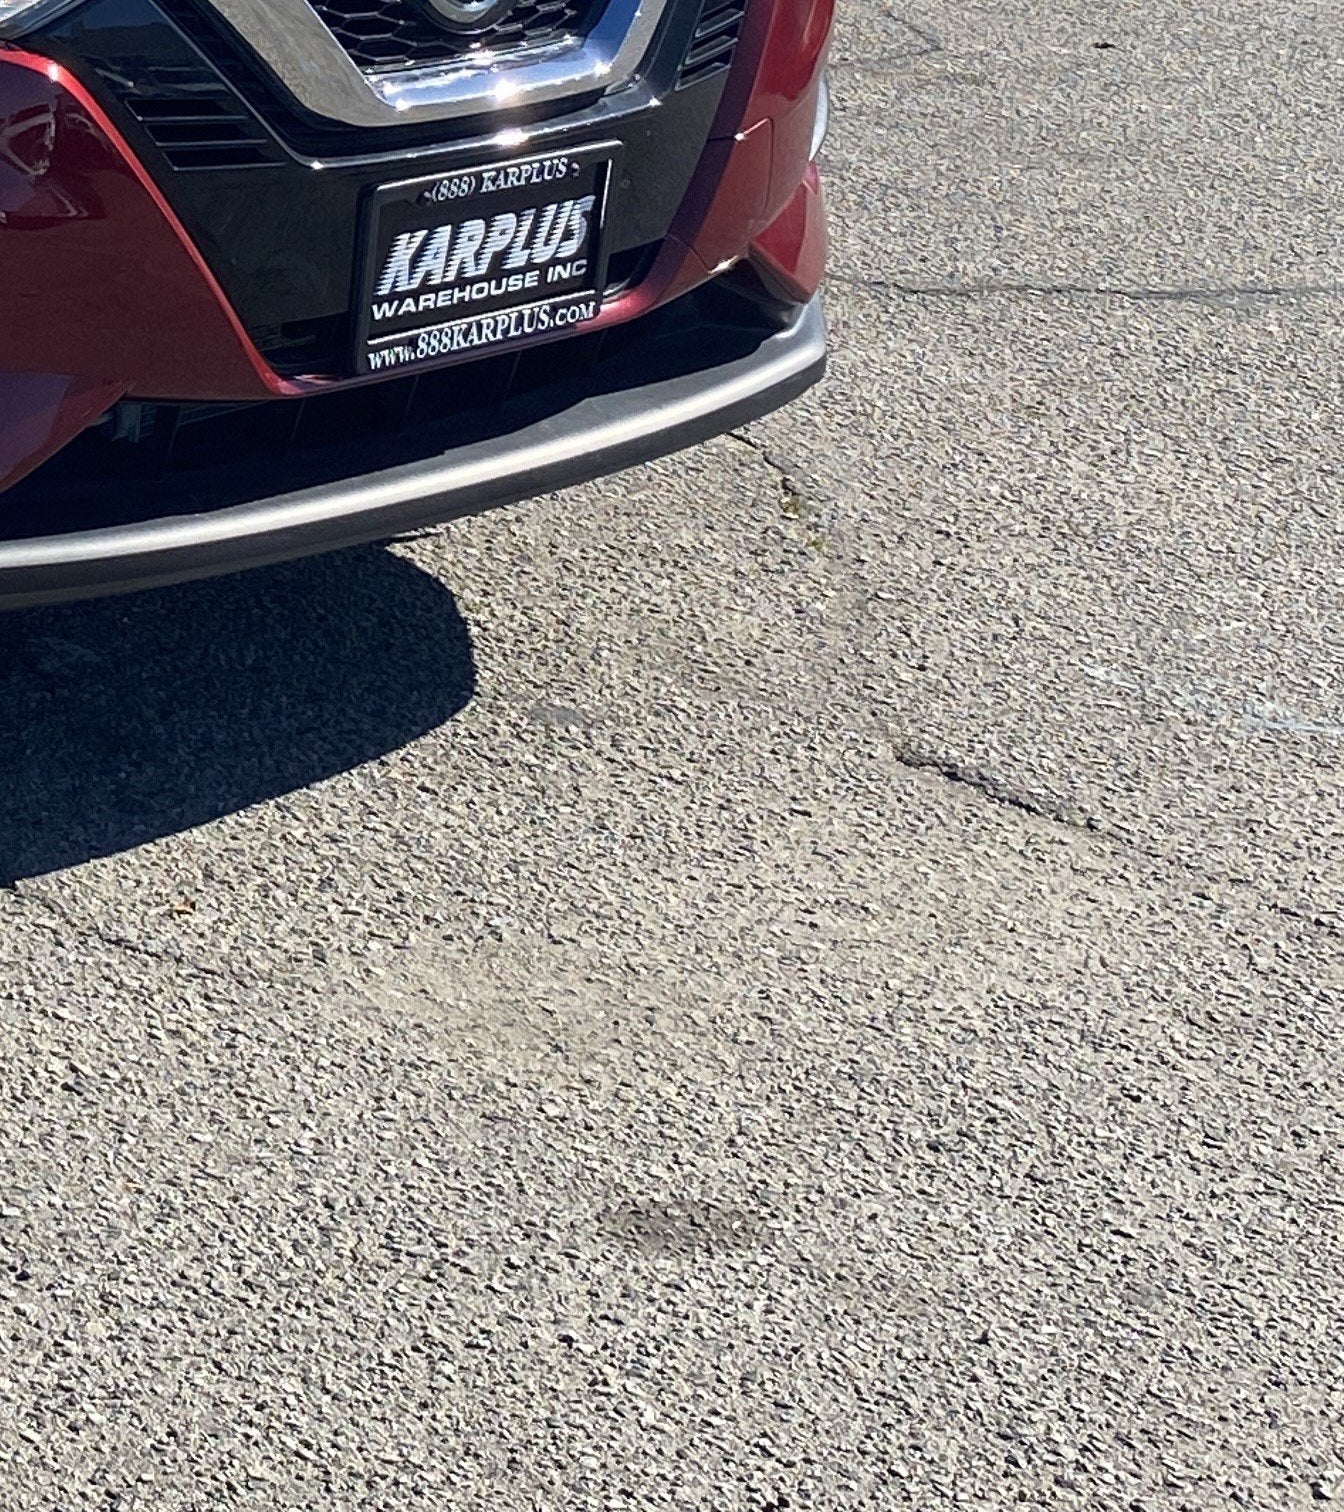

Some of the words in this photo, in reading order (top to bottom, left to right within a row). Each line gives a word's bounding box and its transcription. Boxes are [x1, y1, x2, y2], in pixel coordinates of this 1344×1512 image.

[431, 175, 476, 203] (888)
[480, 157, 568, 194] KARPLUS
[374, 195, 596, 296] KARPLUS
[371, 270, 540, 321] WAREHOUSE
[547, 259, 588, 284] INC
